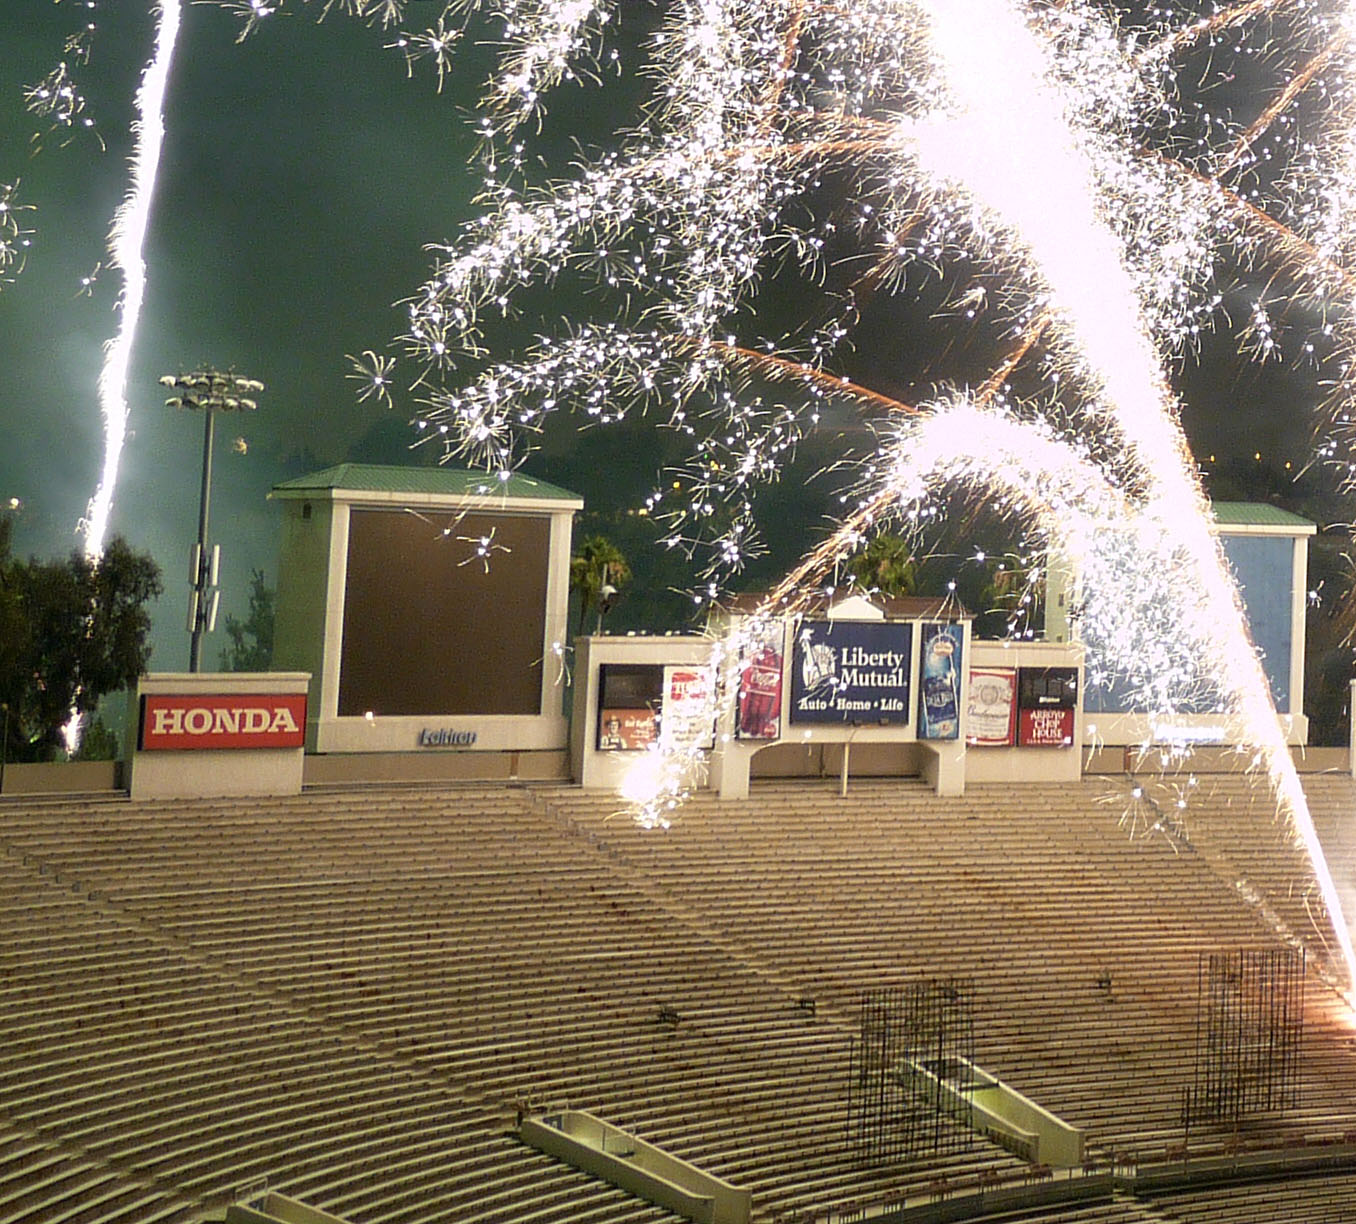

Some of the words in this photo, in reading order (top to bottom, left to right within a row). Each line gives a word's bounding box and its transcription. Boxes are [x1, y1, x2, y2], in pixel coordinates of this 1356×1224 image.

[841, 646, 904, 674] Liberty
[799, 698, 827, 710] Auto
[836, 698, 872, 711] Home
[880, 698, 904, 711] Life
[152, 707, 299, 735] HONDA
